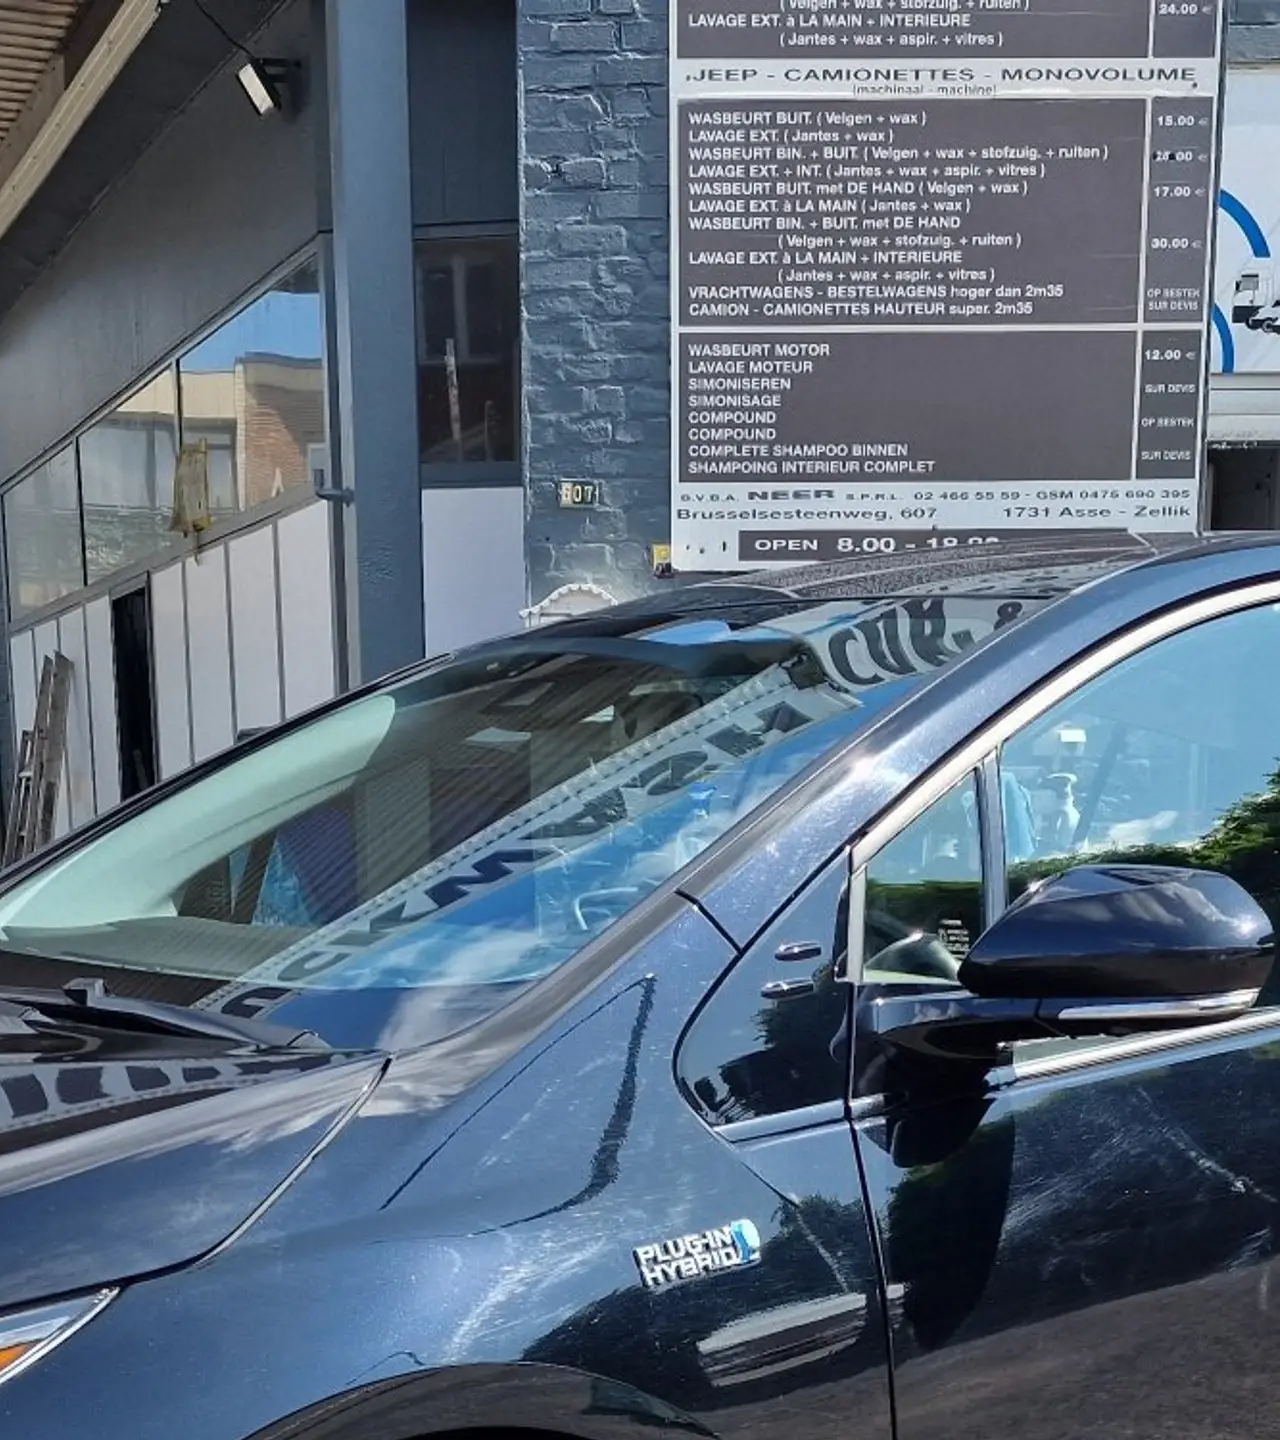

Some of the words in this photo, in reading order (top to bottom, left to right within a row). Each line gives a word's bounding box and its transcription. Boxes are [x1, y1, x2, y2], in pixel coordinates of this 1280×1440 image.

[1158, 4, 1198, 15] 24.00
[688, 14, 746, 27] LAVAGE
[751, 14, 781, 27] EXT.
[800, 14, 818, 26] LA
[823, 14, 862, 26] MAIN
[880, 13, 970, 26] INTERIEURE
[788, 34, 836, 46] Jantes
[853, 35, 882, 46] wax
[955, 32, 994, 46] vitres
[784, 68, 974, 82] CAMIONETTES
[1001, 67, 1196, 81] MONOVOLUME
[688, 112, 771, 124] WASBEURT
[777, 112, 812, 124] BUIT.
[826, 112, 871, 128] Velgen
[890, 114, 918, 124] wax
[688, 130, 745, 142] LAVAGE
[750, 130, 780, 142] EXT.
[792, 130, 839, 142] Jantes
[856, 132, 885, 142] wax
[688, 148, 771, 160] WASBEURT
[777, 148, 806, 160] BIN.
[824, 148, 858, 160] BUIT.
[872, 148, 918, 163] Velgen
[936, 150, 964, 160] wax
[688, 165, 745, 178] LAVAGE
[750, 165, 779, 178] EXT.
[834, 165, 881, 178] Jantes
[899, 168, 927, 178] wax
[999, 165, 1036, 178] vitres
[688, 182, 771, 195] WASBEURT
[777, 182, 812, 195] BUIT.
[816, 182, 842, 195] met
[847, 182, 867, 195] DE
[872, 182, 914, 195] HAND
[928, 182, 974, 198] Velgen
[992, 185, 1019, 195] wax
[688, 200, 745, 212] LAVAGE
[750, 200, 779, 212] EXT.
[796, 200, 814, 212] LA
[819, 200, 857, 212] MAIN
[870, 200, 916, 212] Jantes
[934, 203, 962, 212] wax
[688, 217, 771, 230] WASBEURT
[777, 217, 804, 230] BIN.
[822, 217, 858, 230] BUIT.
[863, 217, 888, 230] met
[894, 217, 914, 230] DE
[918, 217, 960, 230] HAND
[786, 236, 832, 250] Velgen
[850, 238, 878, 247] wax
[972, 236, 1012, 247] ruiten
[688, 252, 745, 264] LAVAGE
[750, 252, 778, 264] EXT.
[796, 252, 814, 264] LA
[819, 252, 856, 264] MAIN
[874, 252, 962, 264] INTERIEURE
[786, 270, 833, 282] Jantes
[850, 272, 878, 282] wax
[948, 270, 987, 282] vitres
[688, 286, 814, 298] VRACHTWAGENS
[828, 286, 946, 298] BESTELWAGENS
[996, 286, 1021, 298] dan
[689, 303, 749, 316] CAMION
[763, 303, 870, 316] CAMIONETTES
[874, 303, 945, 316] HAUTEUR
[688, 344, 770, 356] WASBEURT
[775, 344, 830, 356] MOTOR
[1144, 350, 1181, 360] 12.00
[688, 361, 744, 374] LAVAGE
[750, 361, 813, 374] MOTEUR
[688, 378, 791, 390] SIMONISEREN
[688, 396, 781, 408] SIMONISAGE
[688, 412, 776, 424] COMPOUND
[688, 428, 776, 440] COMPOUND
[688, 445, 768, 457] COMPLETE
[773, 444, 848, 457] SHAMPOO
[852, 444, 908, 456] BINNEN
[688, 462, 778, 474] SHAMPOING
[782, 461, 860, 474] INTERIEUR
[864, 460, 936, 472] COMPLET
[748, 490, 835, 500] NEER
[677, 508, 893, 522] Brusselsesteenweg,
[900, 508, 937, 518] 607
[1003, 507, 1050, 518] 1731
[1059, 507, 1112, 518] Asse
[1134, 506, 1190, 517] Zellik
[754, 539, 818, 550] OPEN
[837, 538, 896, 552] 8.00
[640, 1247, 742, 1287] HYBRID
